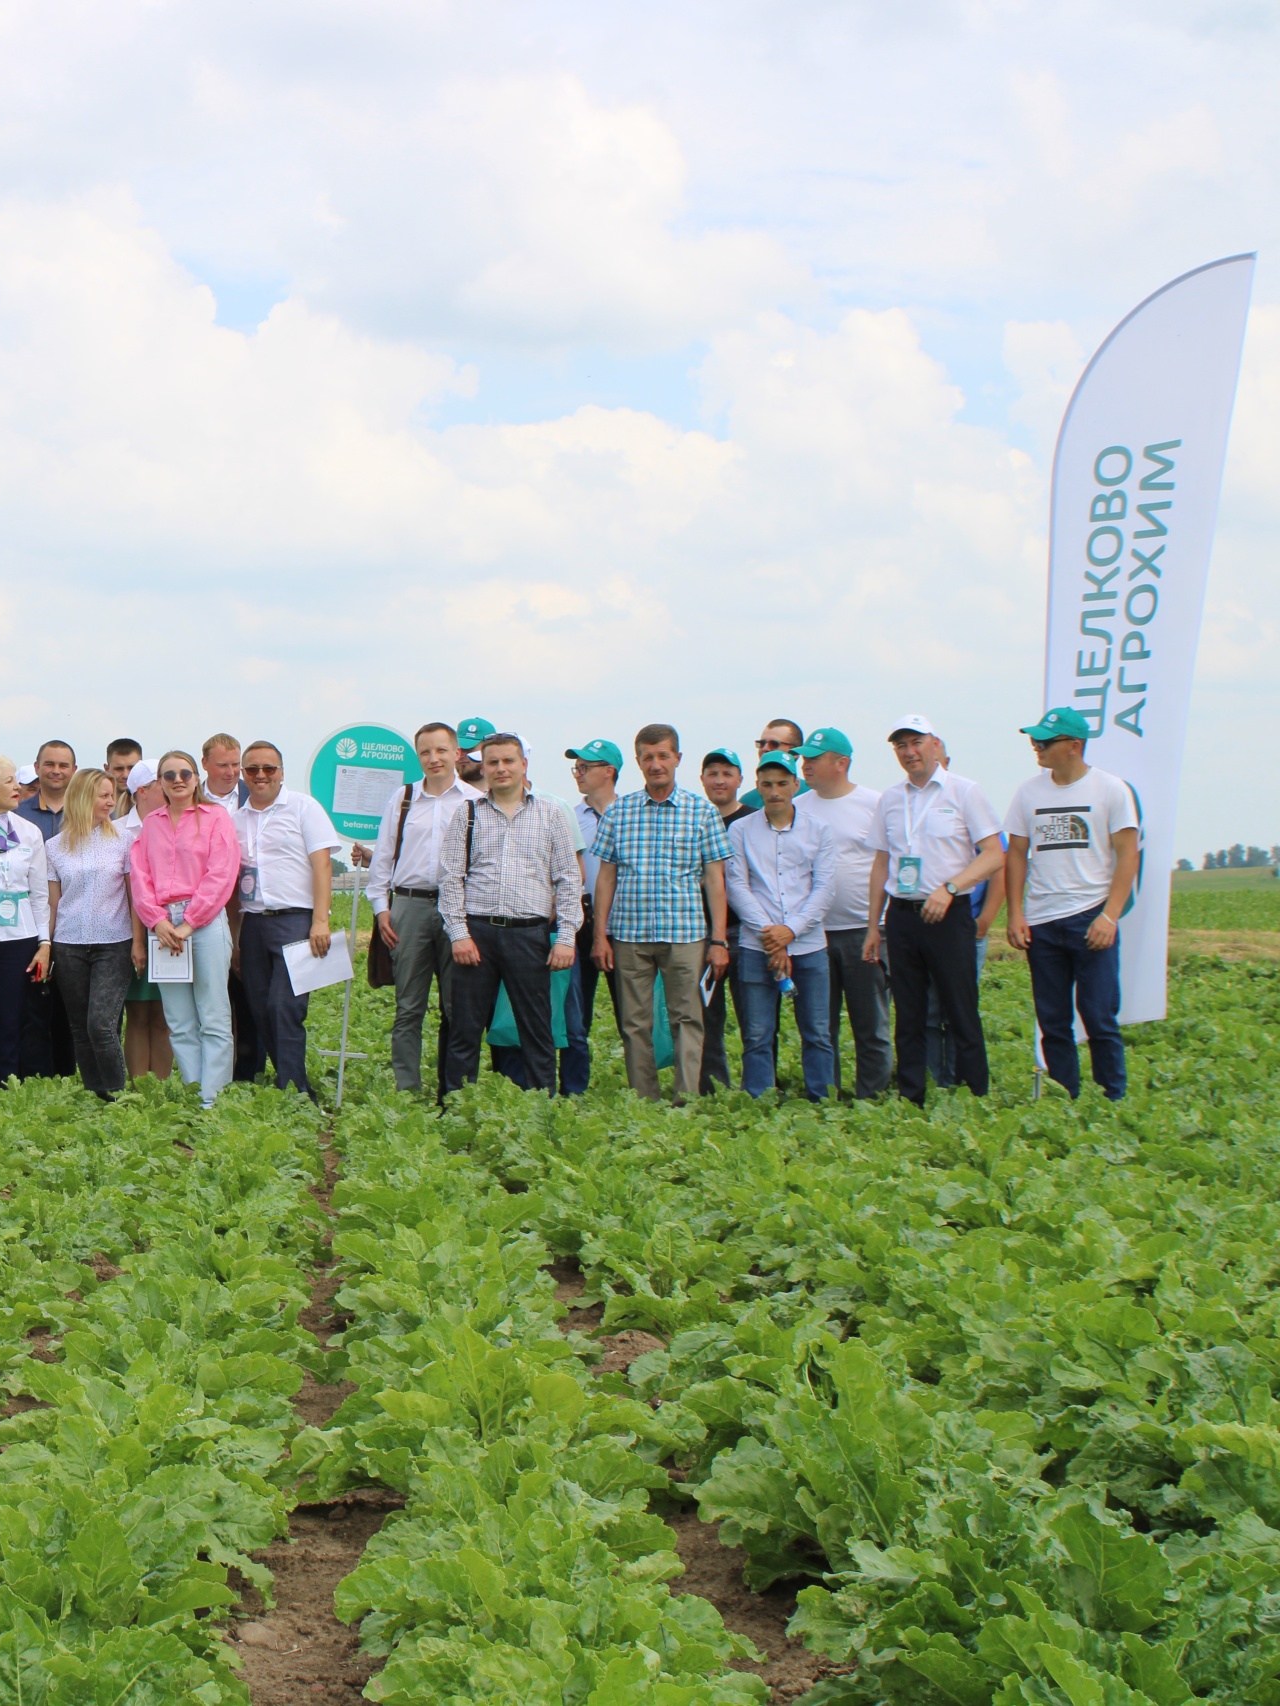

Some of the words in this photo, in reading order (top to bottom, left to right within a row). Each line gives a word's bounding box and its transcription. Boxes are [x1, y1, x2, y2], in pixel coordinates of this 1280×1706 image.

[1074, 445, 1134, 739] ЩЕЛКОВО
[1114, 438, 1182, 738] АГРОХИМ
[361, 742, 405, 753] ЩЕЛКОВО
[360, 751, 404, 761] АГРОХИМ
[1050, 815, 1070, 824] THE
[343, 820, 379, 830] befaren.r
[1035, 824, 1070, 834] NORTH
[1044, 832, 1070, 842] FACE
